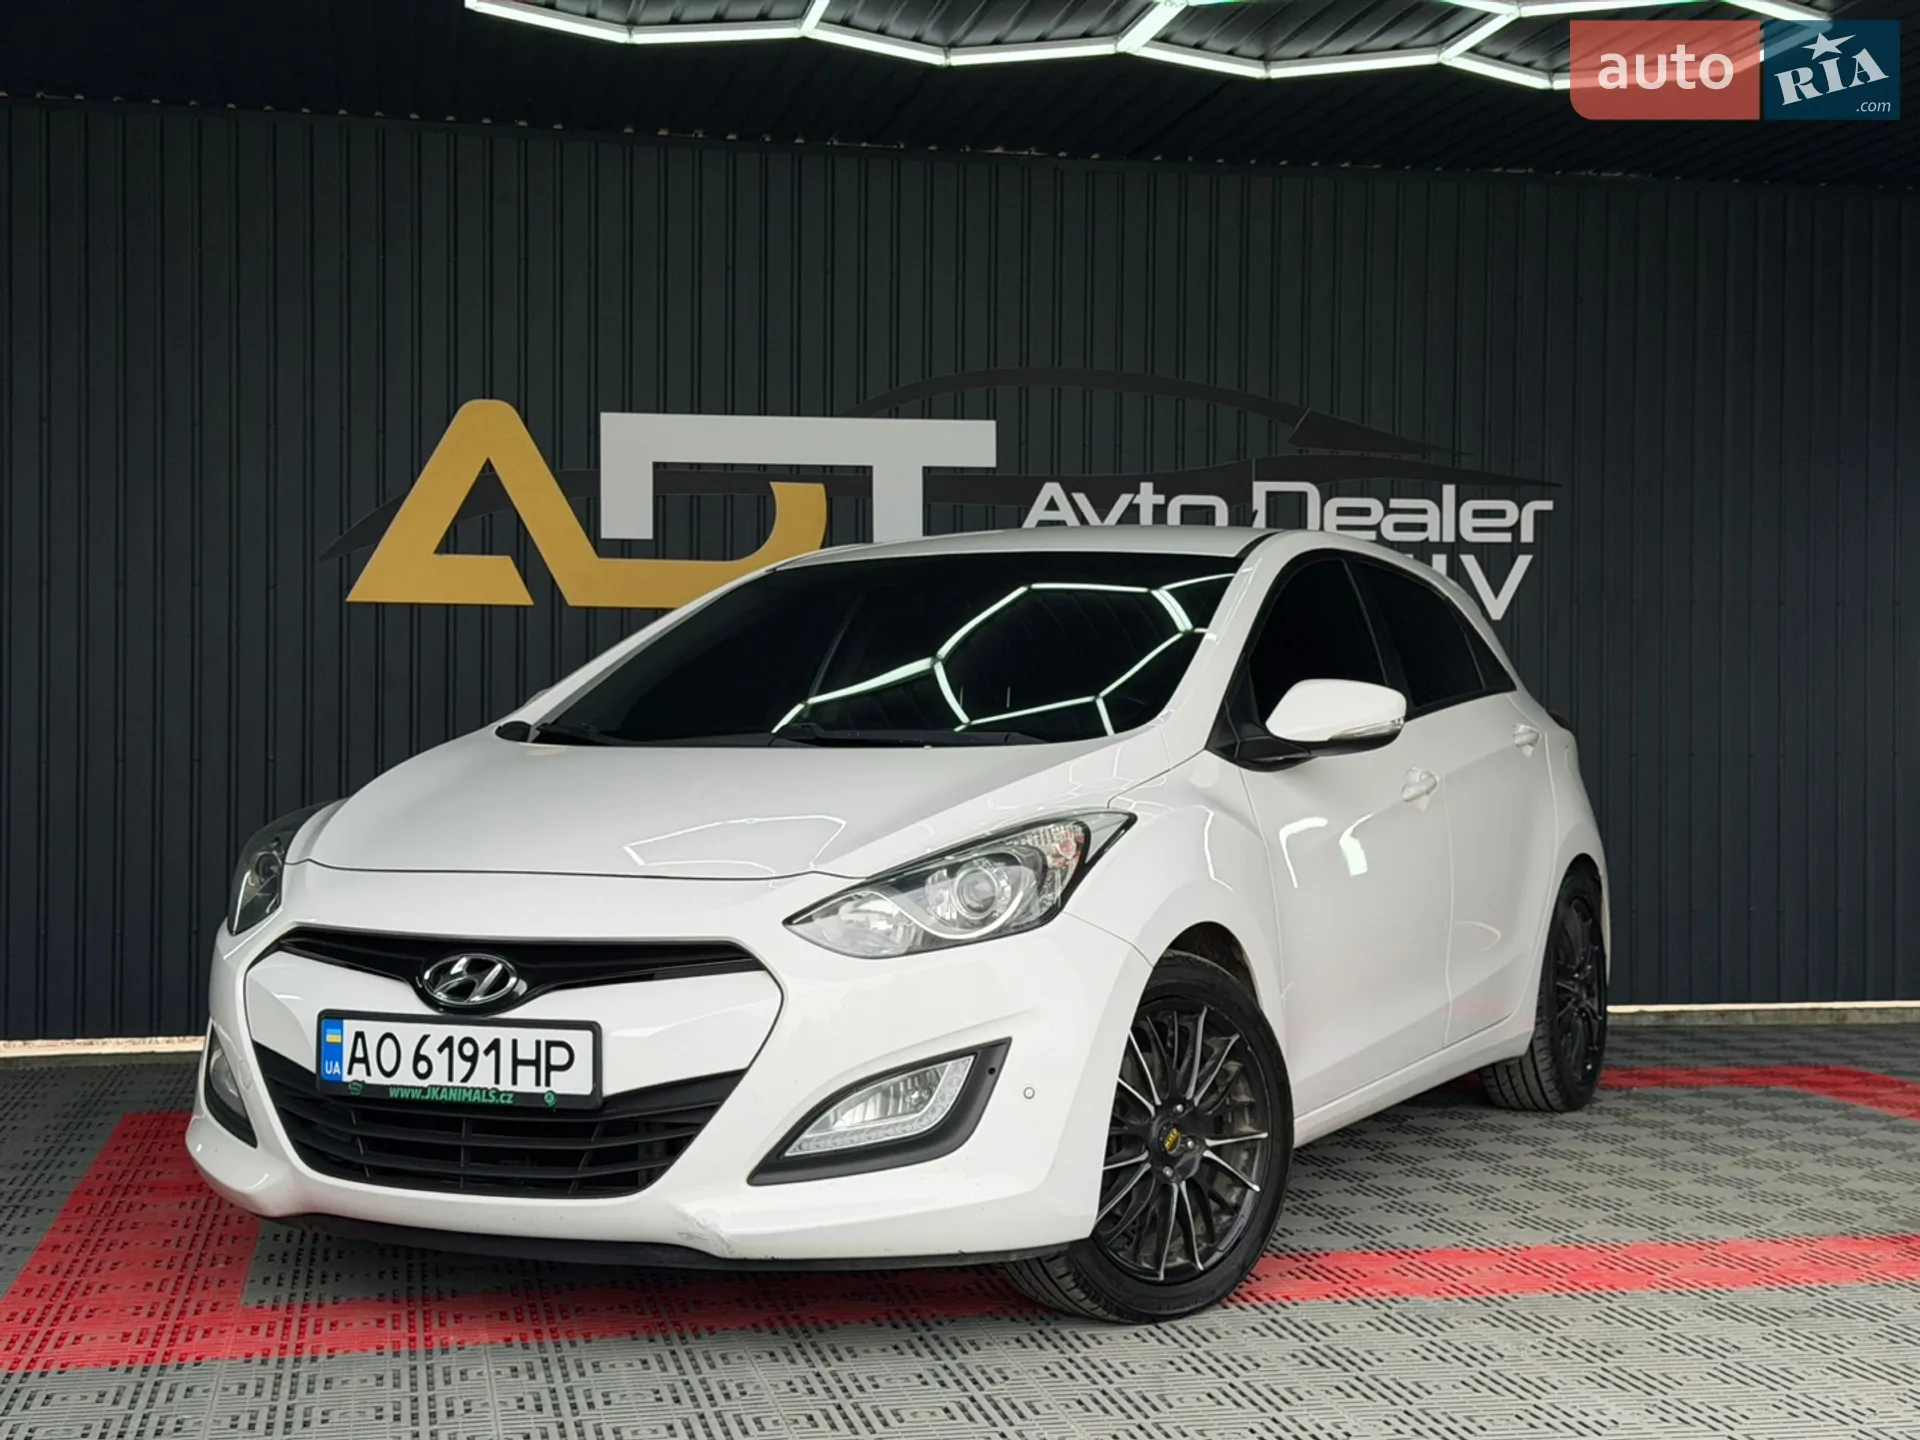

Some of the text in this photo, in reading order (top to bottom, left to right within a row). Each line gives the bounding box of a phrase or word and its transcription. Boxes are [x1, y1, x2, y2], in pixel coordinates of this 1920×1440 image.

[1021, 481, 1554, 543] Avto Dealer
[325, 1060, 341, 1075] UA
[347, 1030, 575, 1087] AO 6191 HP
